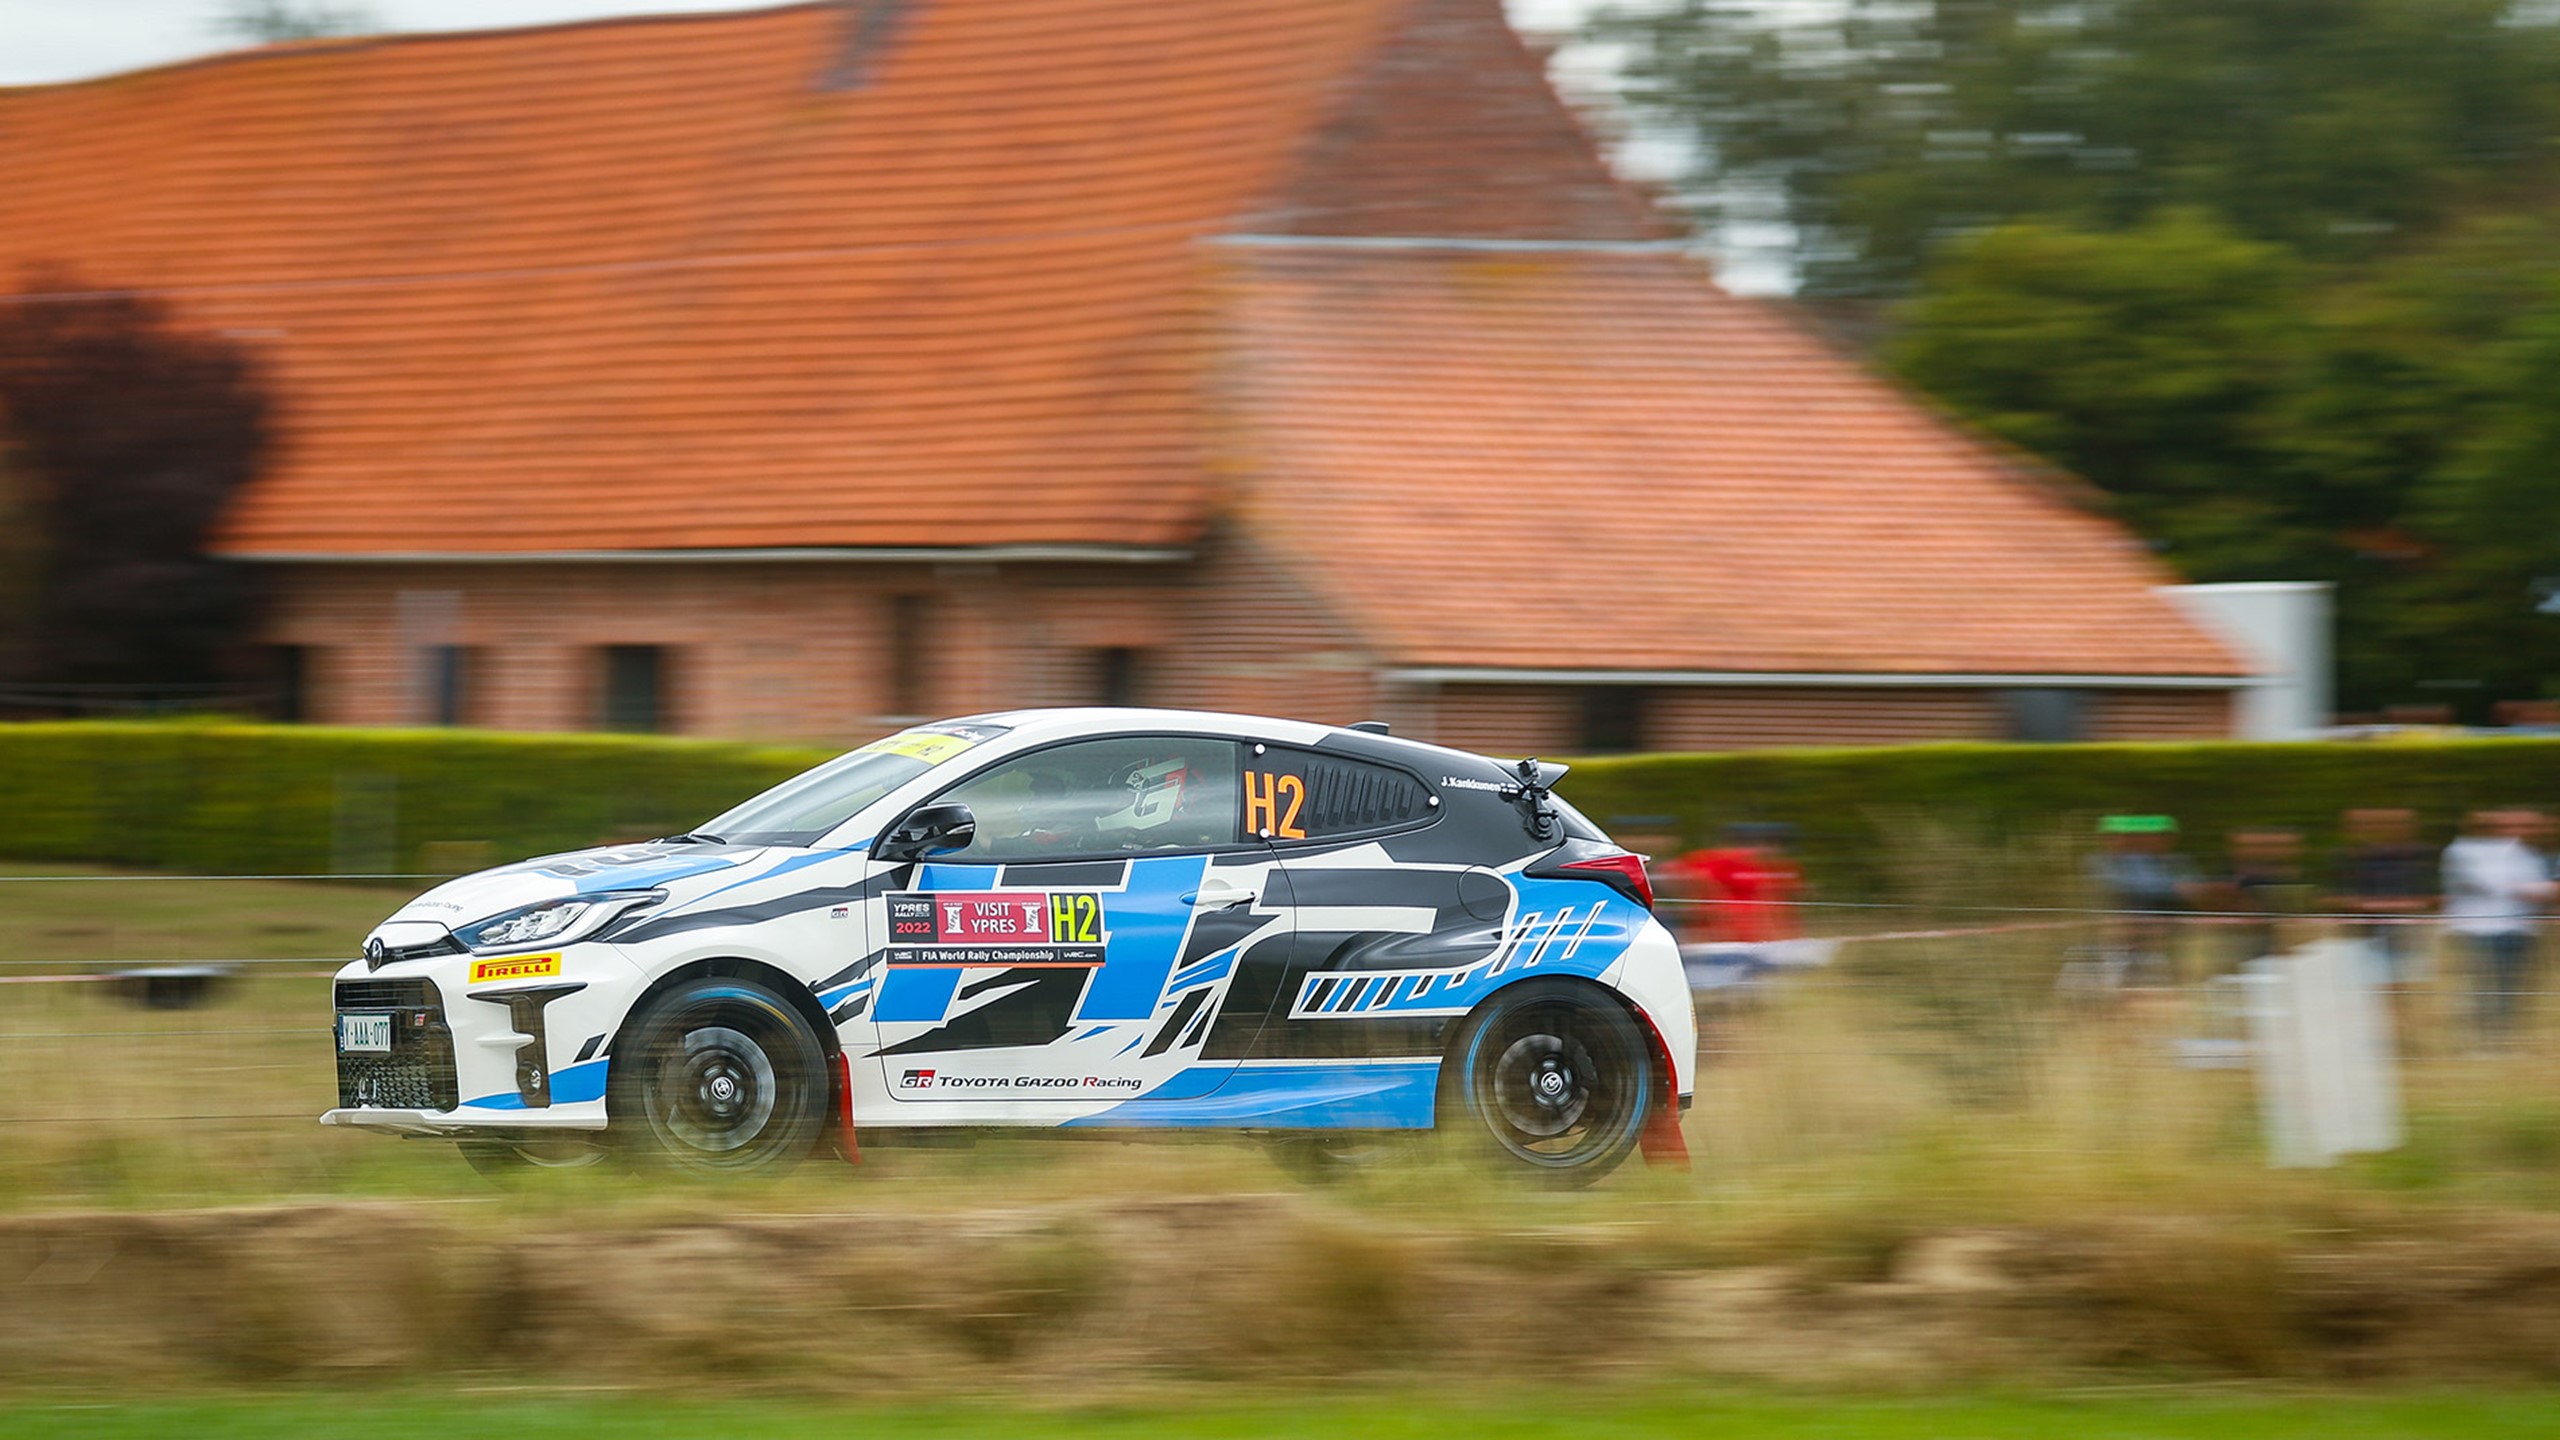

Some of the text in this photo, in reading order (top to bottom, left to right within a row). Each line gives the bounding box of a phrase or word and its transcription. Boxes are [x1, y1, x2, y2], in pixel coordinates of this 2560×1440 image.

[1244, 770, 1306, 839] H2
[894, 903, 930, 912] YPRES
[974, 902, 1010, 916] VISIT
[1052, 895, 1097, 941] H2
[896, 921, 931, 934] 2022
[970, 919, 1017, 933] YPRES
[922, 950, 1054, 962] FIA World Rally Championship
[477, 958, 552, 978] PIRELLI
[900, 1075, 1143, 1091] GR TOYOTA GAZOO Racing
